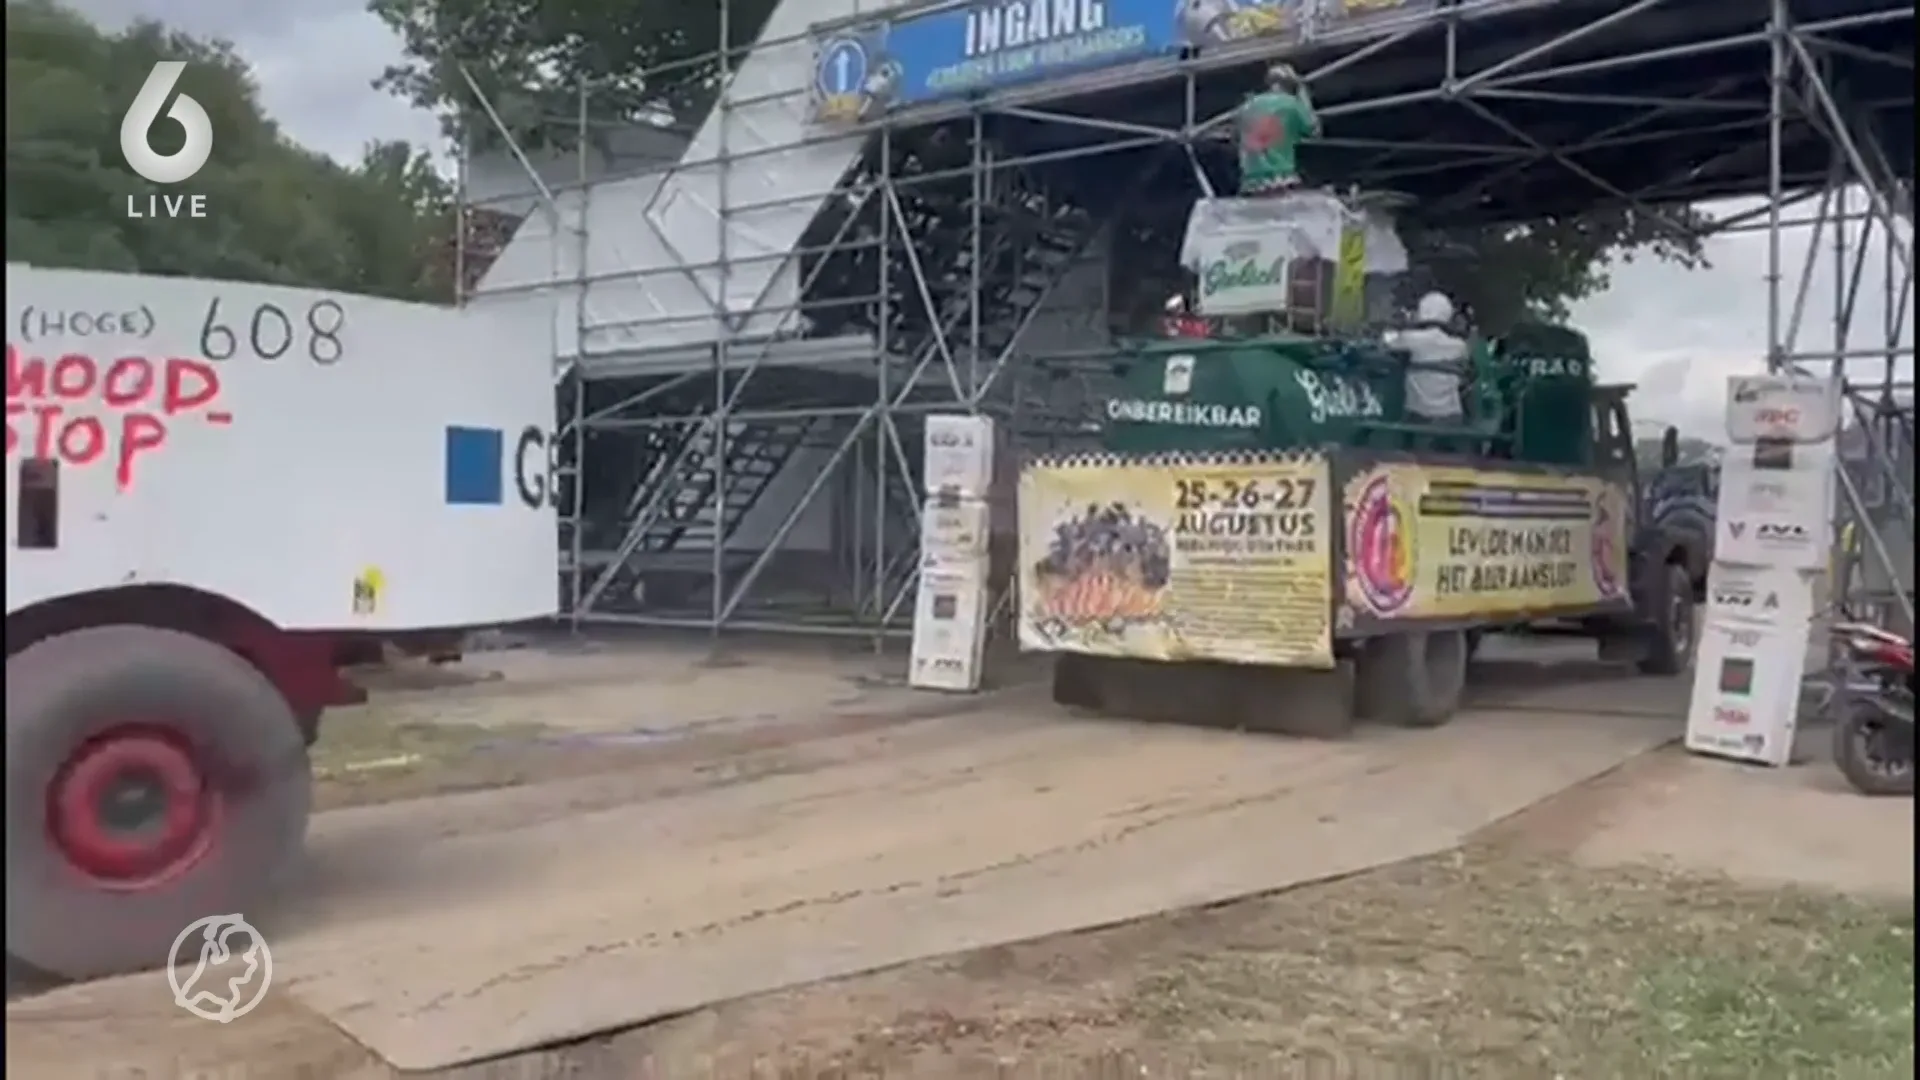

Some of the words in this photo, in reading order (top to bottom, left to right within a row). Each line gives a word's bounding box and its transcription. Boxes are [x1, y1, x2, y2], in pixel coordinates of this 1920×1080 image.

[964, 0, 1105, 56] INGANG
[20, 305, 156, 342] (HOGE)
[200, 296, 345, 364] 608
[1175, 479, 1316, 509] 25-26-27
[1175, 512, 1316, 536] AUGUSTUS
